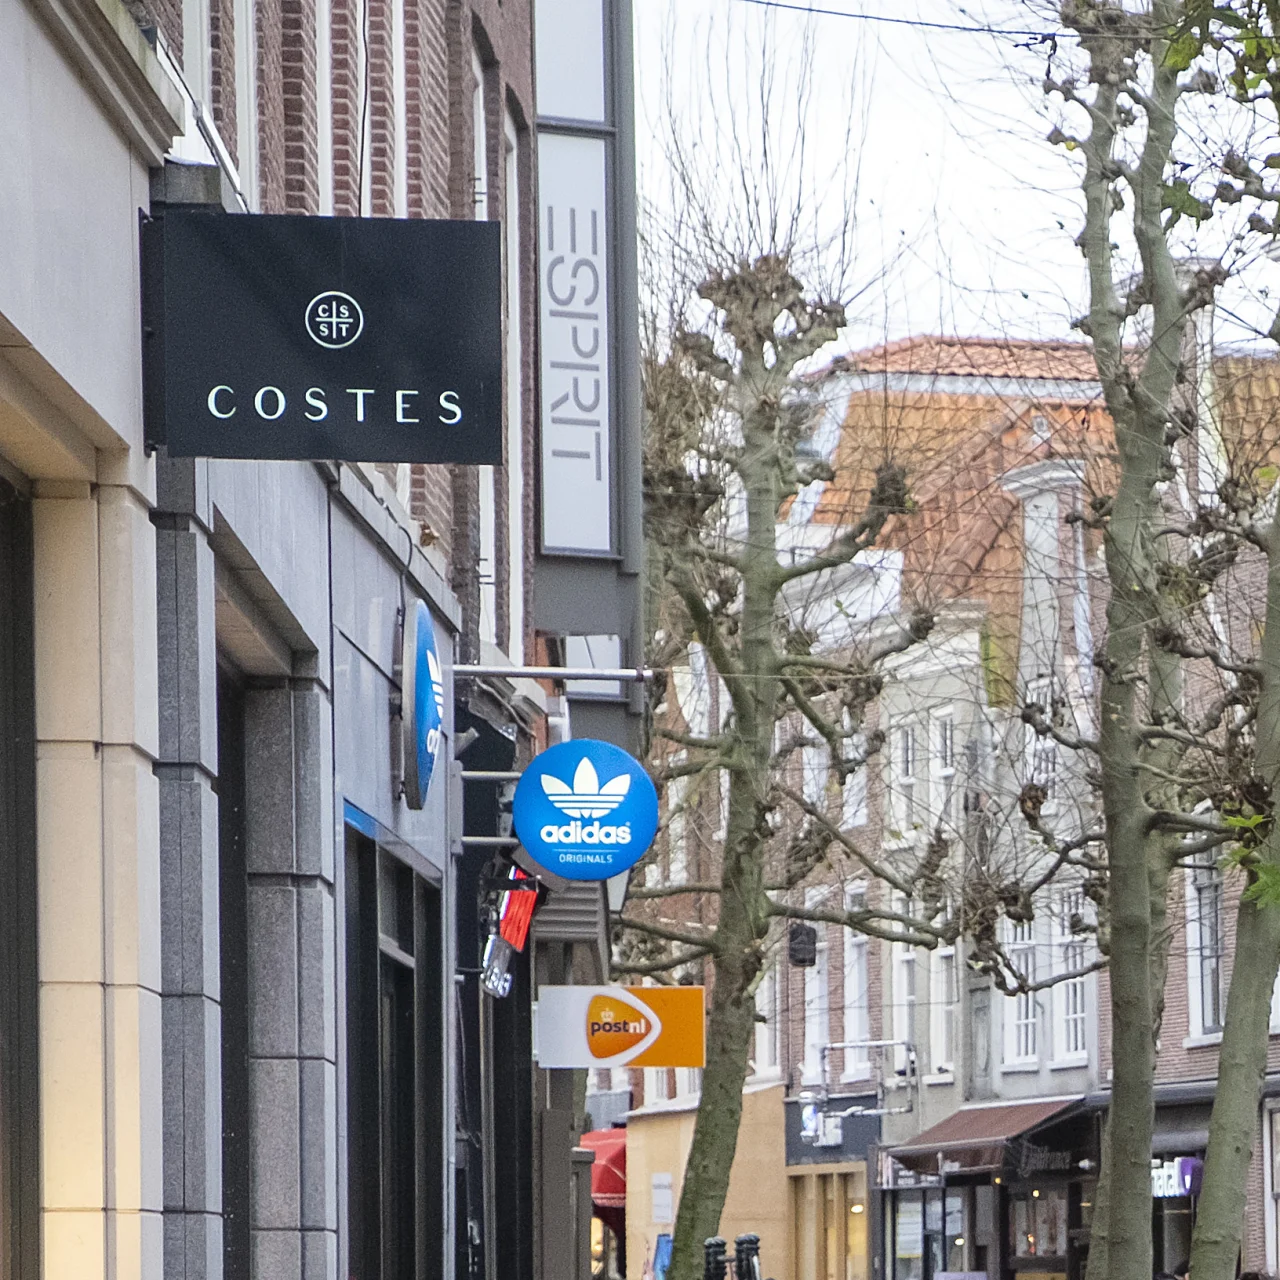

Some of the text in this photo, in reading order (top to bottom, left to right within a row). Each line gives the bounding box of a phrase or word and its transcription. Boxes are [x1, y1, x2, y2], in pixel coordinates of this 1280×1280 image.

[547, 205, 602, 482] ESPRIT
[207, 384, 463, 425] COSTES
[540, 821, 632, 845] adidas
[558, 853, 613, 864] ORIGINALS
